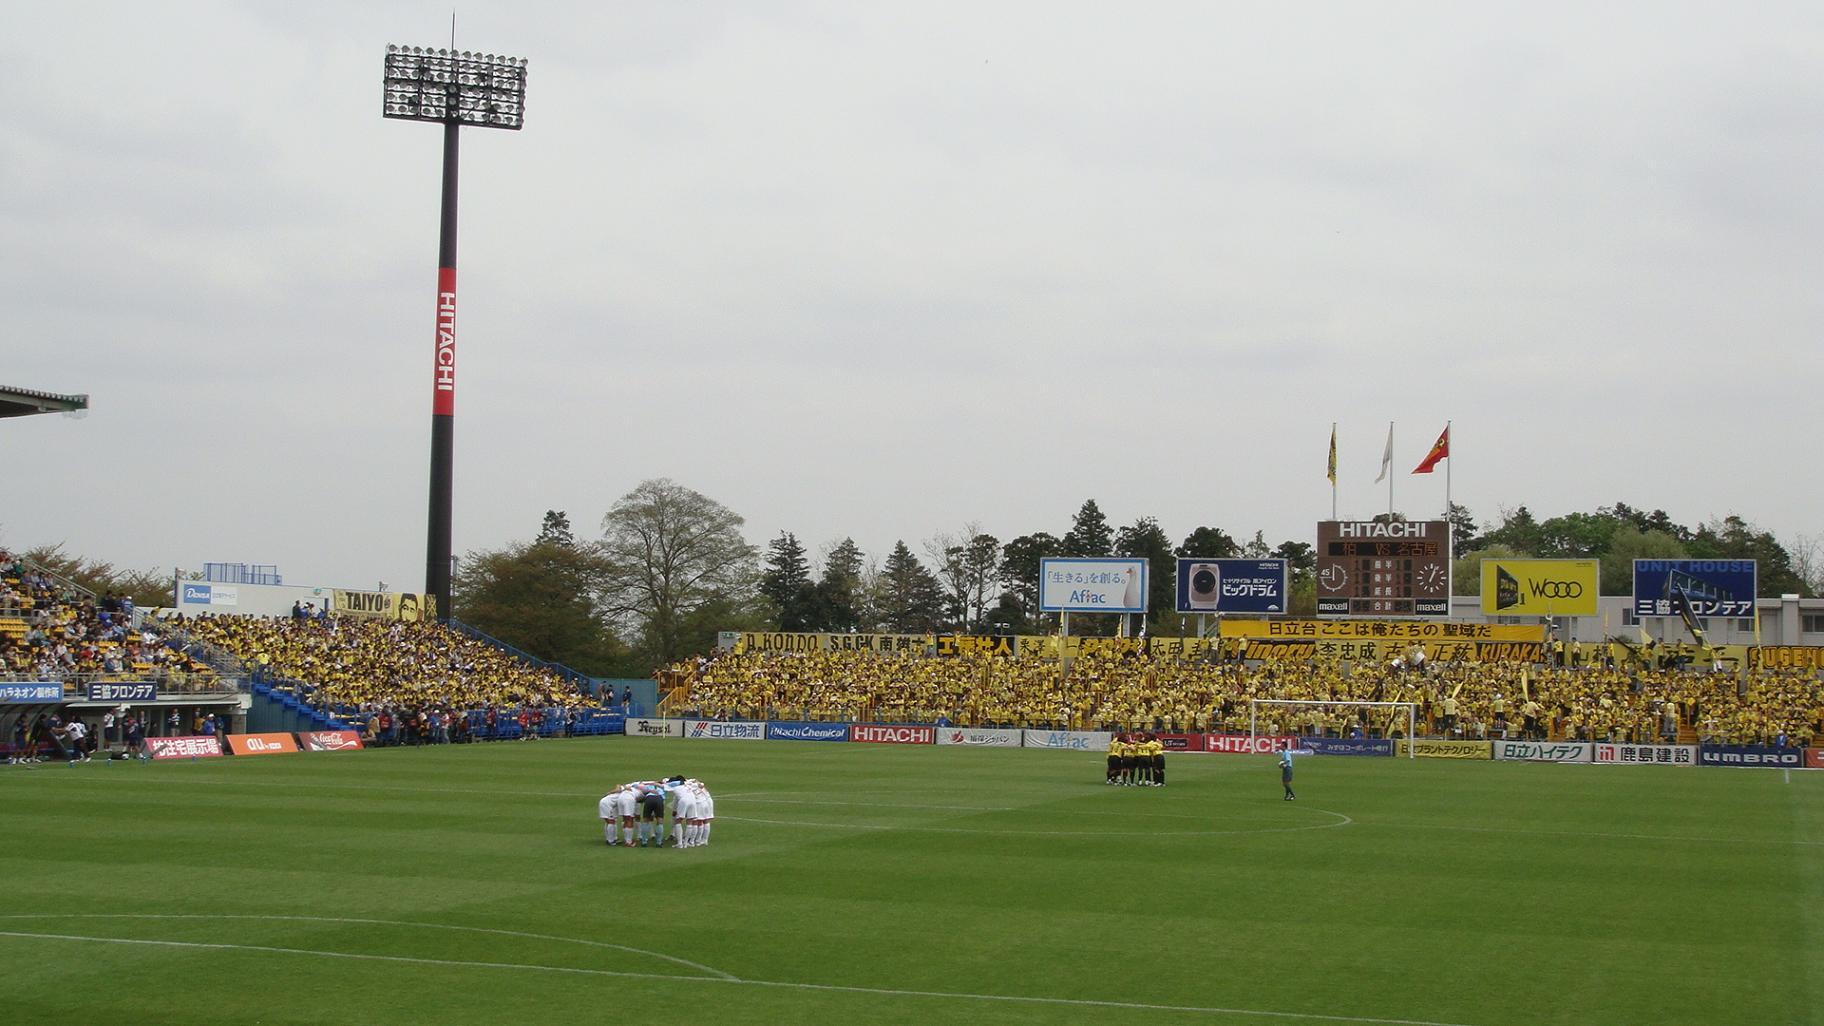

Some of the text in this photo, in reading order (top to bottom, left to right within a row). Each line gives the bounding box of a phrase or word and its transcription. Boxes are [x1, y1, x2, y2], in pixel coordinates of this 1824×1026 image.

[438, 292, 455, 390] HITACHI
[1340, 523, 1425, 537] HITACHI
[1637, 561, 1753, 572] UNIT HOUSE
[346, 591, 384, 612] TAIYO
[1069, 589, 1106, 604] Aflac
[1319, 602, 1348, 611] maxell
[1417, 602, 1446, 612] maxell
[1319, 642, 1377, 660] 李忠成
[92, 685, 153, 699] 三協フロンテア
[711, 724, 760, 737] 日立物流
[770, 726, 845, 738] Hitachi Chemical
[854, 727, 930, 742] HITACHI
[247, 738, 265, 751] au
[1048, 732, 1089, 748] Aflac
[1504, 744, 1583, 759] 日立ハイテク
[1620, 747, 1690, 763] 鹿島建設
